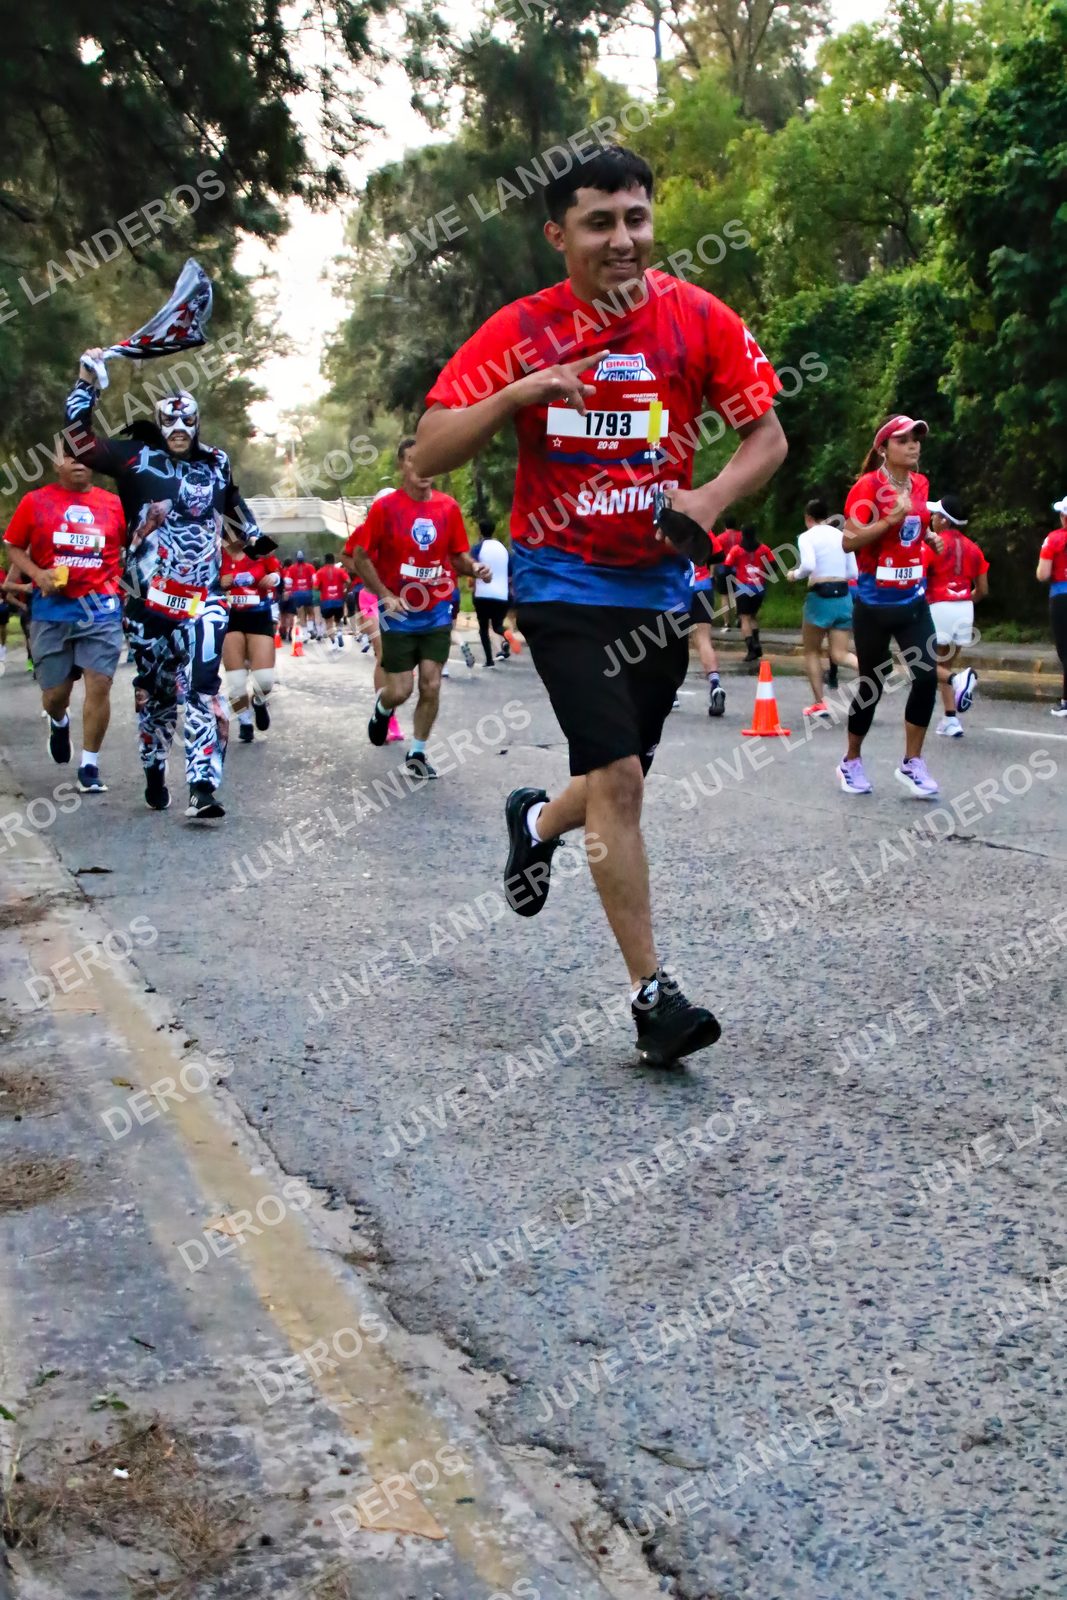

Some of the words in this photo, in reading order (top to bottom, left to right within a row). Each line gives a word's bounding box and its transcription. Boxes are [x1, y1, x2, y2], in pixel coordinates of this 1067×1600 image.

[606, 360, 640, 369] BIMBO
[585, 411, 632, 437] 1793
[576, 480, 679, 516] SANTIA
[69, 534, 90, 545] 2132
[895, 568, 913, 579] 1438
[166, 595, 187, 610] 1815
